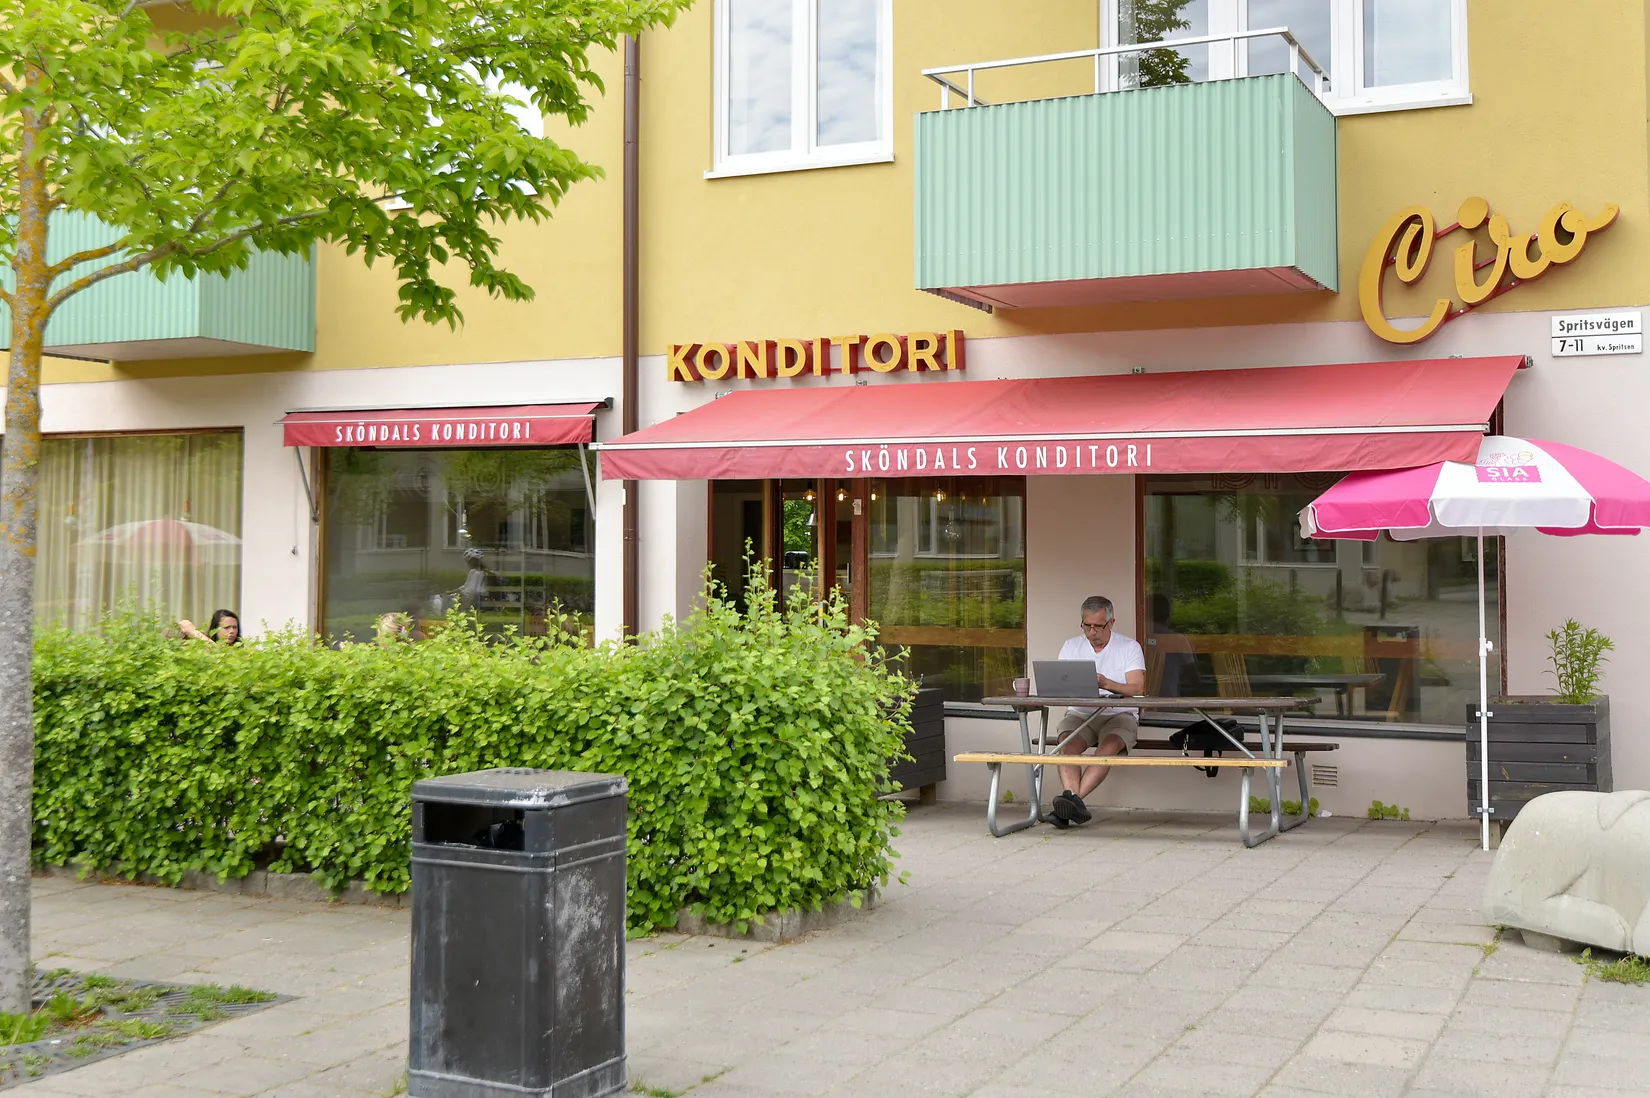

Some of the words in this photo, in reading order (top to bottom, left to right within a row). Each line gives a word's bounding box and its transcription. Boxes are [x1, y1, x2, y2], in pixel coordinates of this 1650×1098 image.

[1358, 196, 1620, 345] Ciro
[1559, 318, 1634, 333] Spritsvägen
[1559, 339, 1584, 352] 7-11
[1608, 344, 1635, 352] Spritsen
[667, 329, 966, 382] KONDITORI
[336, 422, 421, 442] SKÖNDALS
[431, 421, 531, 440] KONDITORI
[845, 444, 978, 472] SKÖNDALS
[998, 444, 1152, 469] KONDITORI
[1485, 467, 1529, 478] SIA
